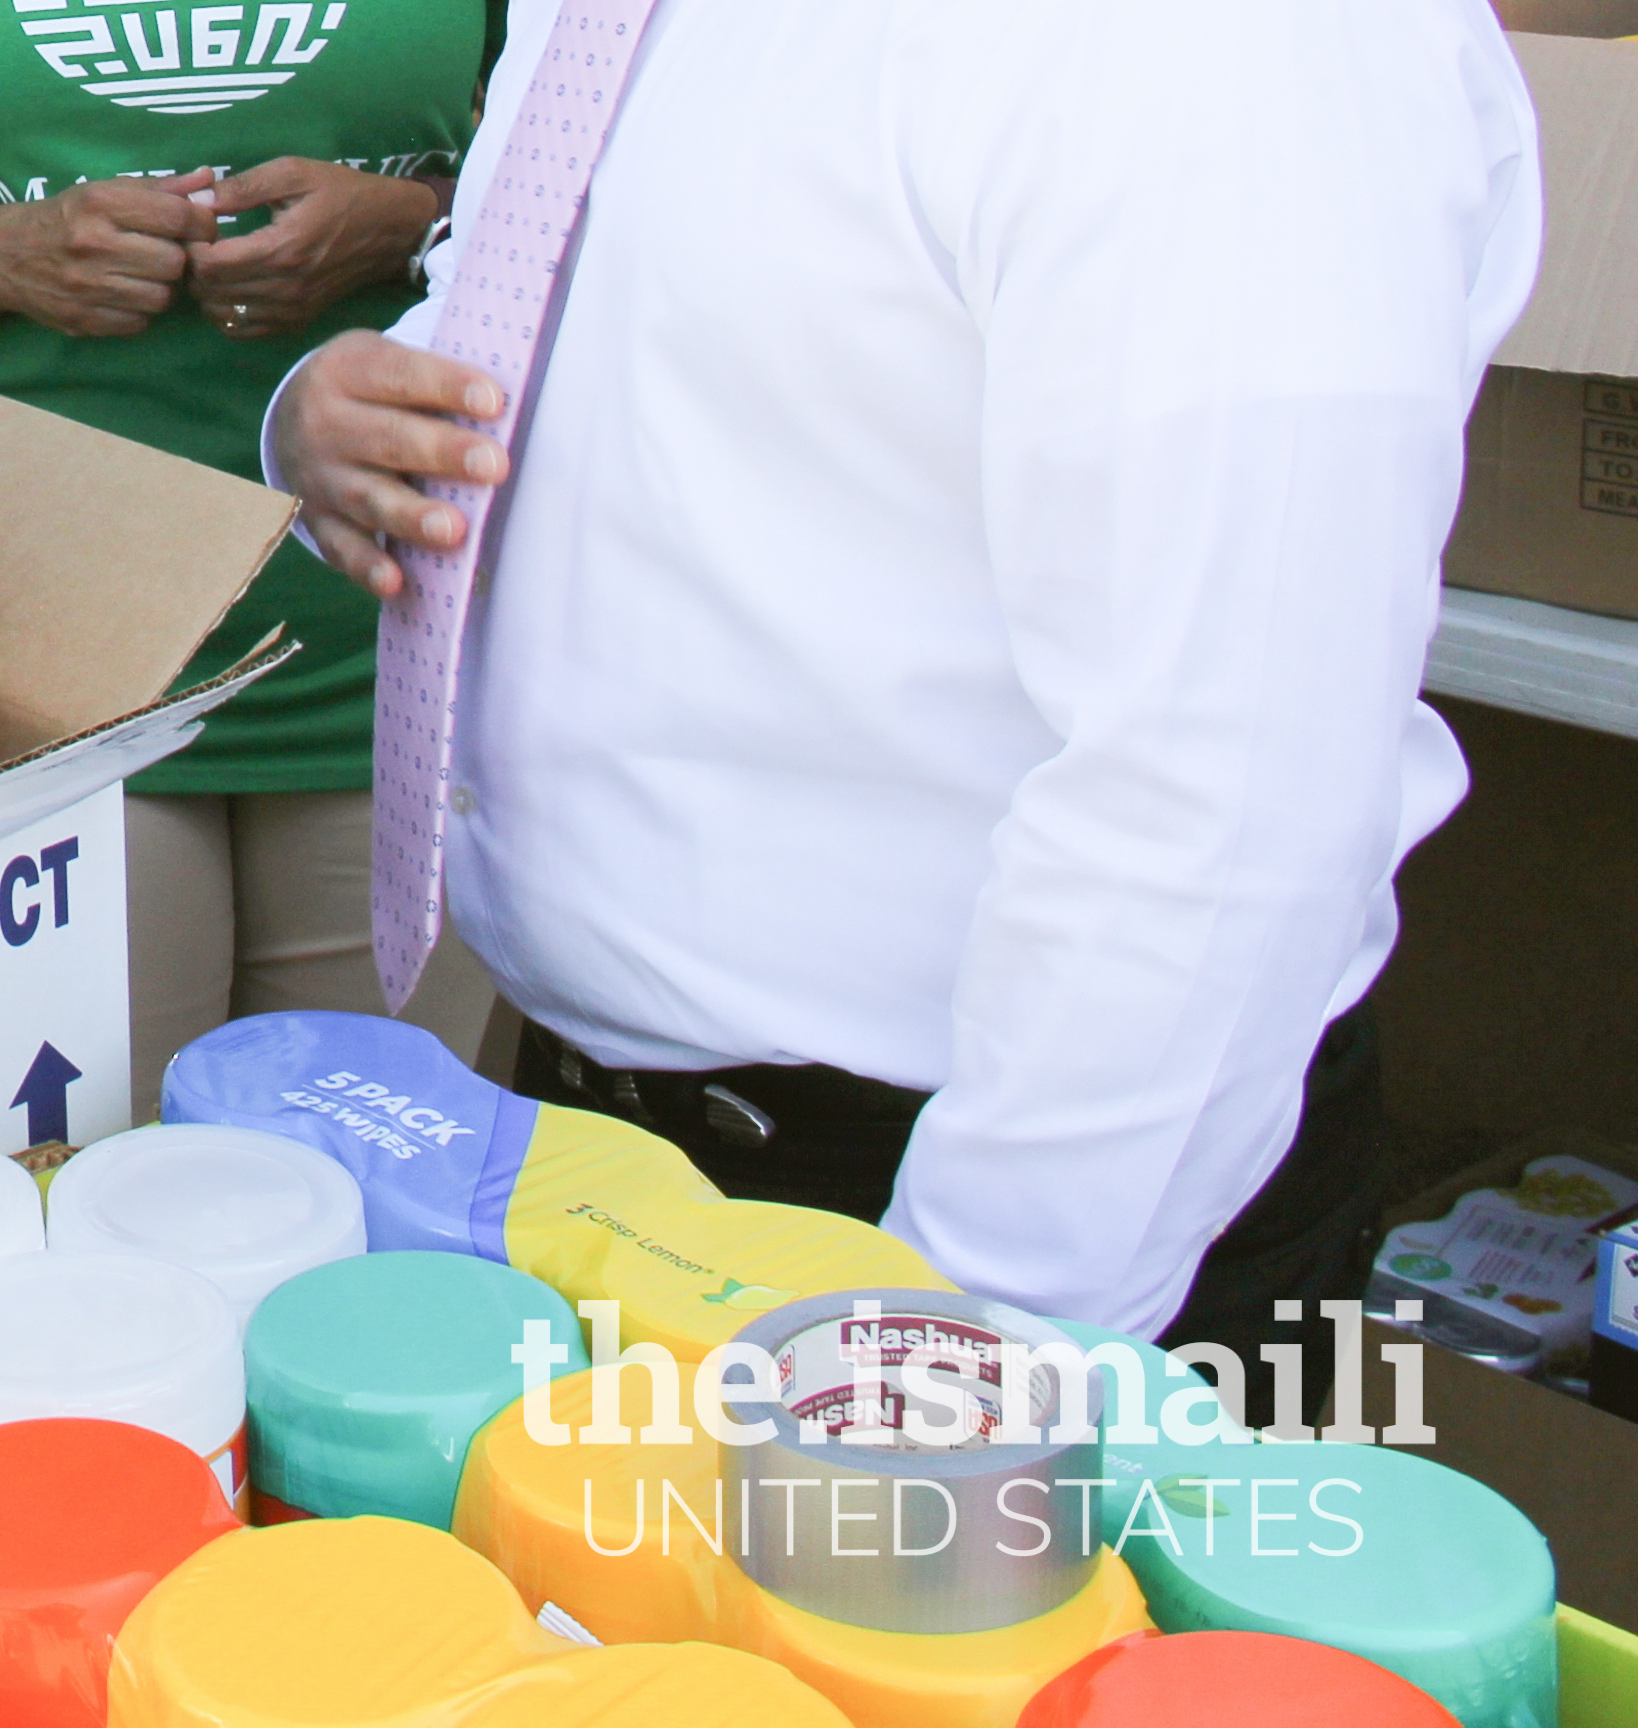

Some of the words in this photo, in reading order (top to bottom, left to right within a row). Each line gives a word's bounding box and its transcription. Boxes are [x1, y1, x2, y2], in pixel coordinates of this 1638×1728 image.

[280, 1091, 339, 1114] 425
[333, 1107, 422, 1160] WIPES
[314, 1071, 361, 1090] 5
[342, 1082, 476, 1146] PACK
[588, 1211, 638, 1239] Crisp
[850, 1322, 992, 1364] Nashua
[863, 1353, 910, 1362] TRUSTED
[806, 1398, 895, 1426] Nash
